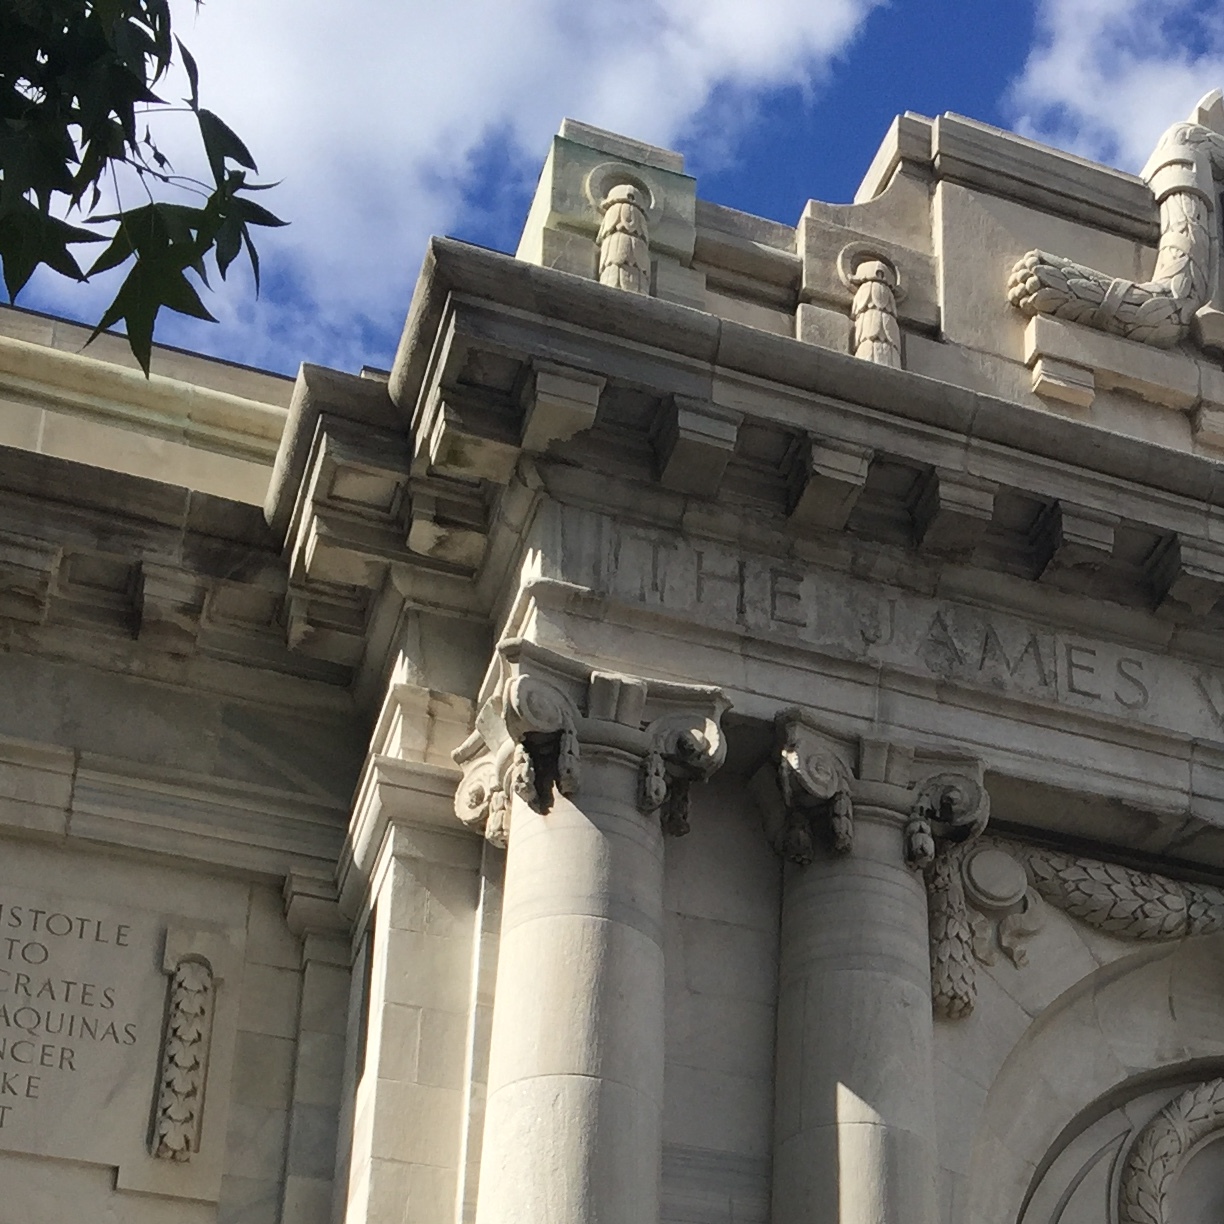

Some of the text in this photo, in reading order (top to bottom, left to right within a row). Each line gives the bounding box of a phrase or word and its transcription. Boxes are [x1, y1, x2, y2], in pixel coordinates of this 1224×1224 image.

[630, 536, 807, 629] THE
[858, 599, 1149, 711] JAMES
[0, 1003, 138, 1046] AQUINAS
